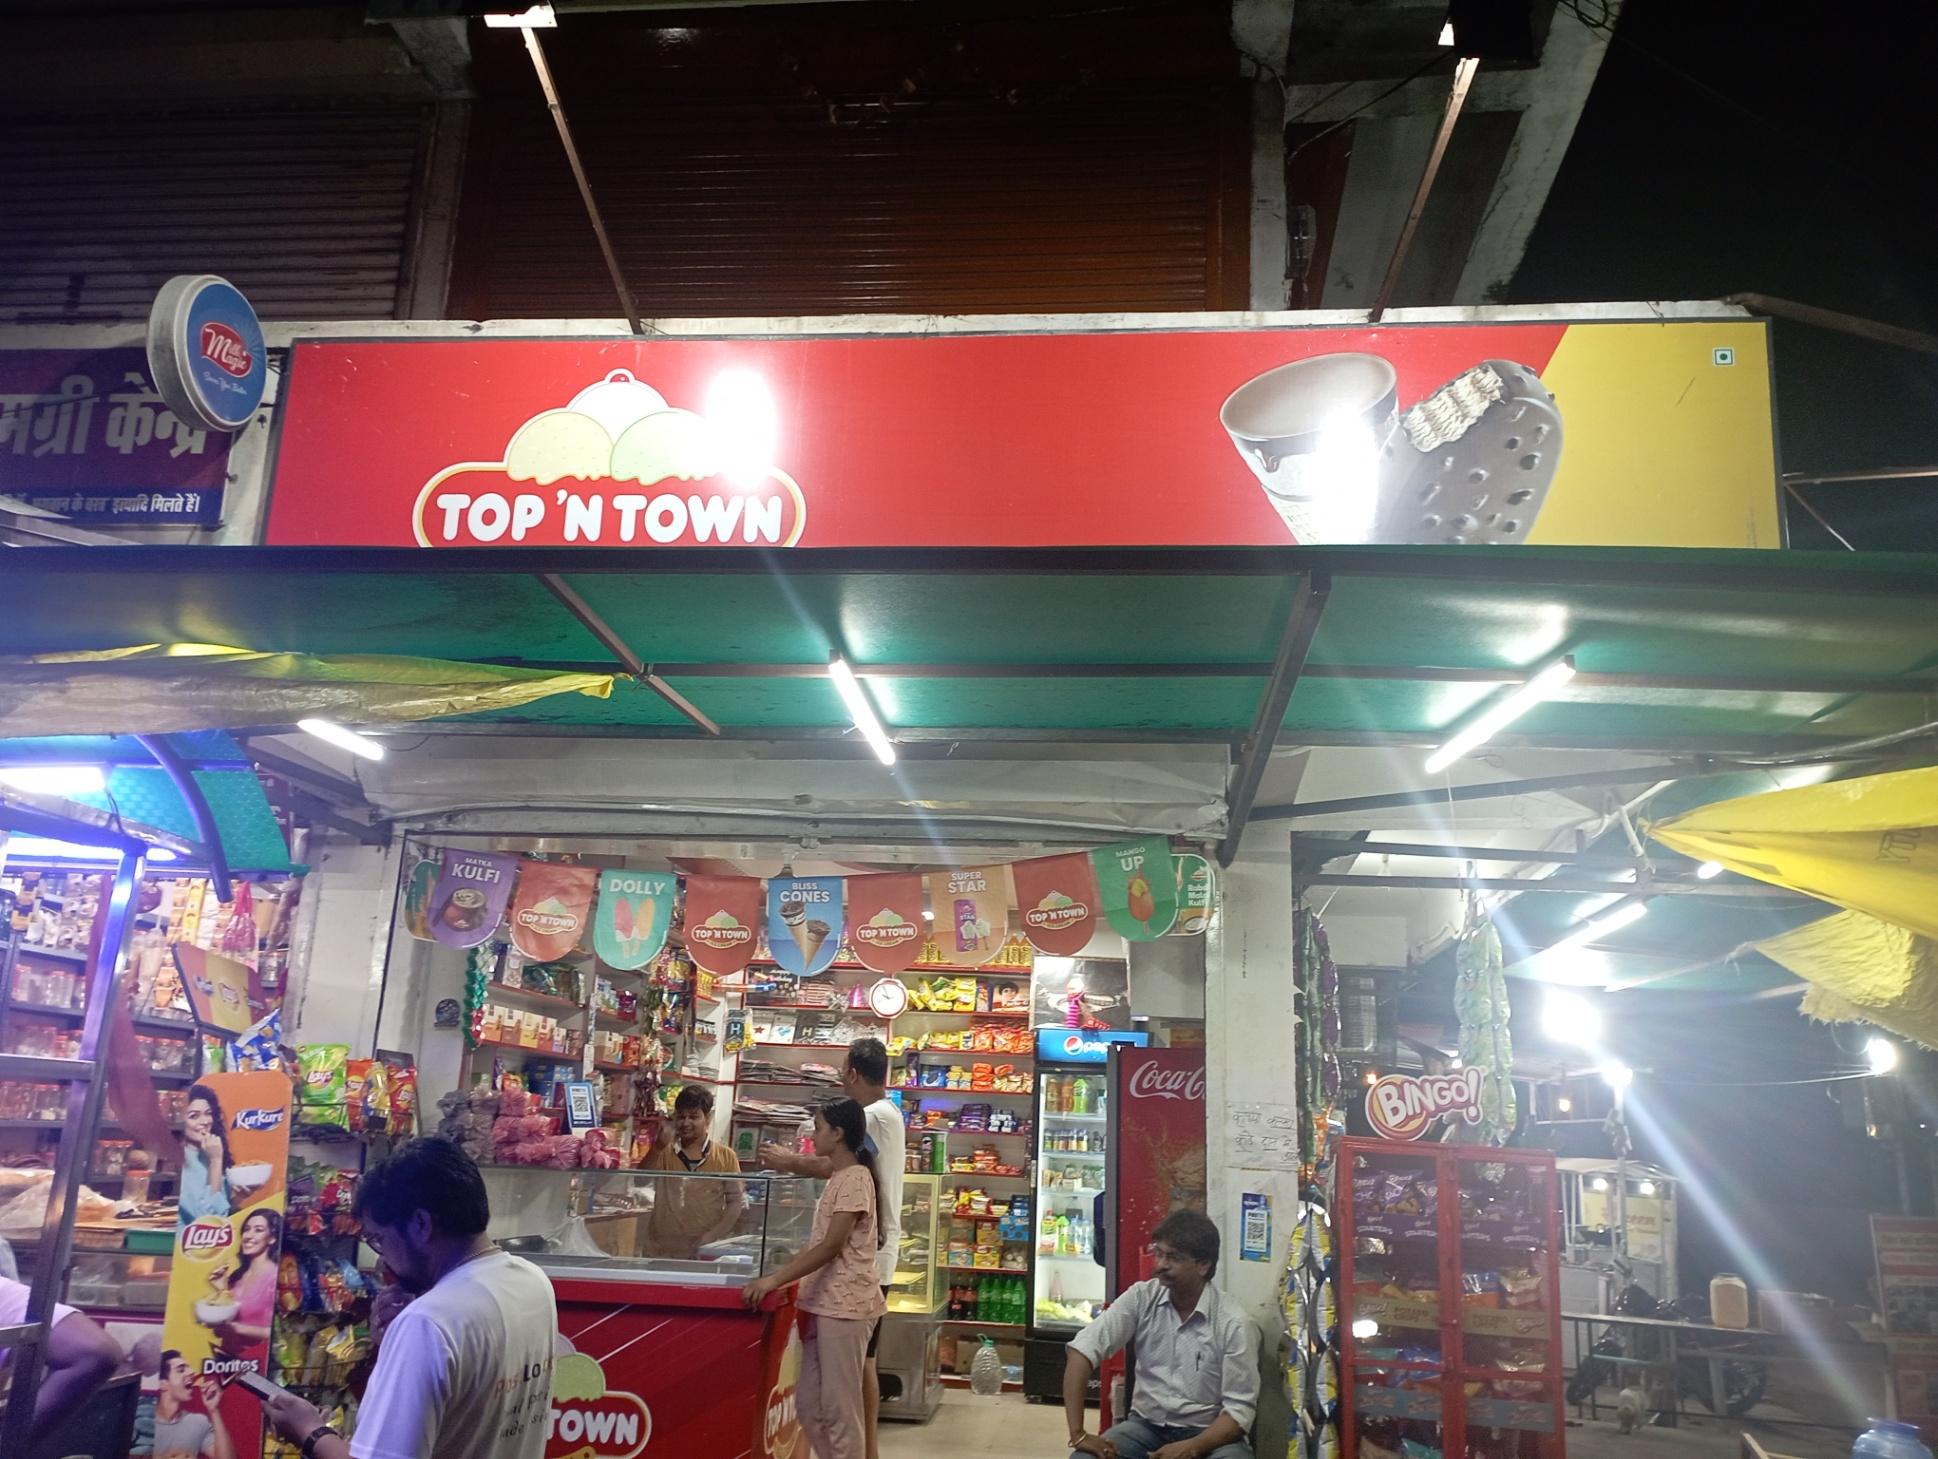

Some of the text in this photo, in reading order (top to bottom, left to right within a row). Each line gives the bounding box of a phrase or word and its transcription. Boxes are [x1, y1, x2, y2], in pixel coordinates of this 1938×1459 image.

[151, 493, 184, 513] मिलते
[437, 489, 783, 544] TOP 'N TOWN
[1121, 855, 1144, 871] UP
[451, 863, 500, 884] KULFI
[951, 871, 982, 881] SUPER
[609, 879, 665, 895] DOLLY
[792, 882, 817, 890] BLISS
[948, 879, 987, 893] STAR
[780, 890, 830, 903] CONES
[521, 913, 539, 923] TOP
[549, 917, 576, 928] TOWN
[1029, 912, 1048, 923] TOP
[1057, 907, 1085, 919] TOWN
[695, 929, 712, 938] TOP
[721, 929, 748, 939] TOWN
[860, 929, 878, 938] TOP
[887, 927, 914, 937] TOWN
[1083, 1041, 1111, 1054] pep
[1130, 1060, 1205, 1100] Coca-C
[1376, 1069, 1480, 1127] BINGO!
[236, 1109, 284, 1130] Kurkure
[203, 1359, 259, 1375] Doritos
[546, 1408, 639, 1446] TOWN
